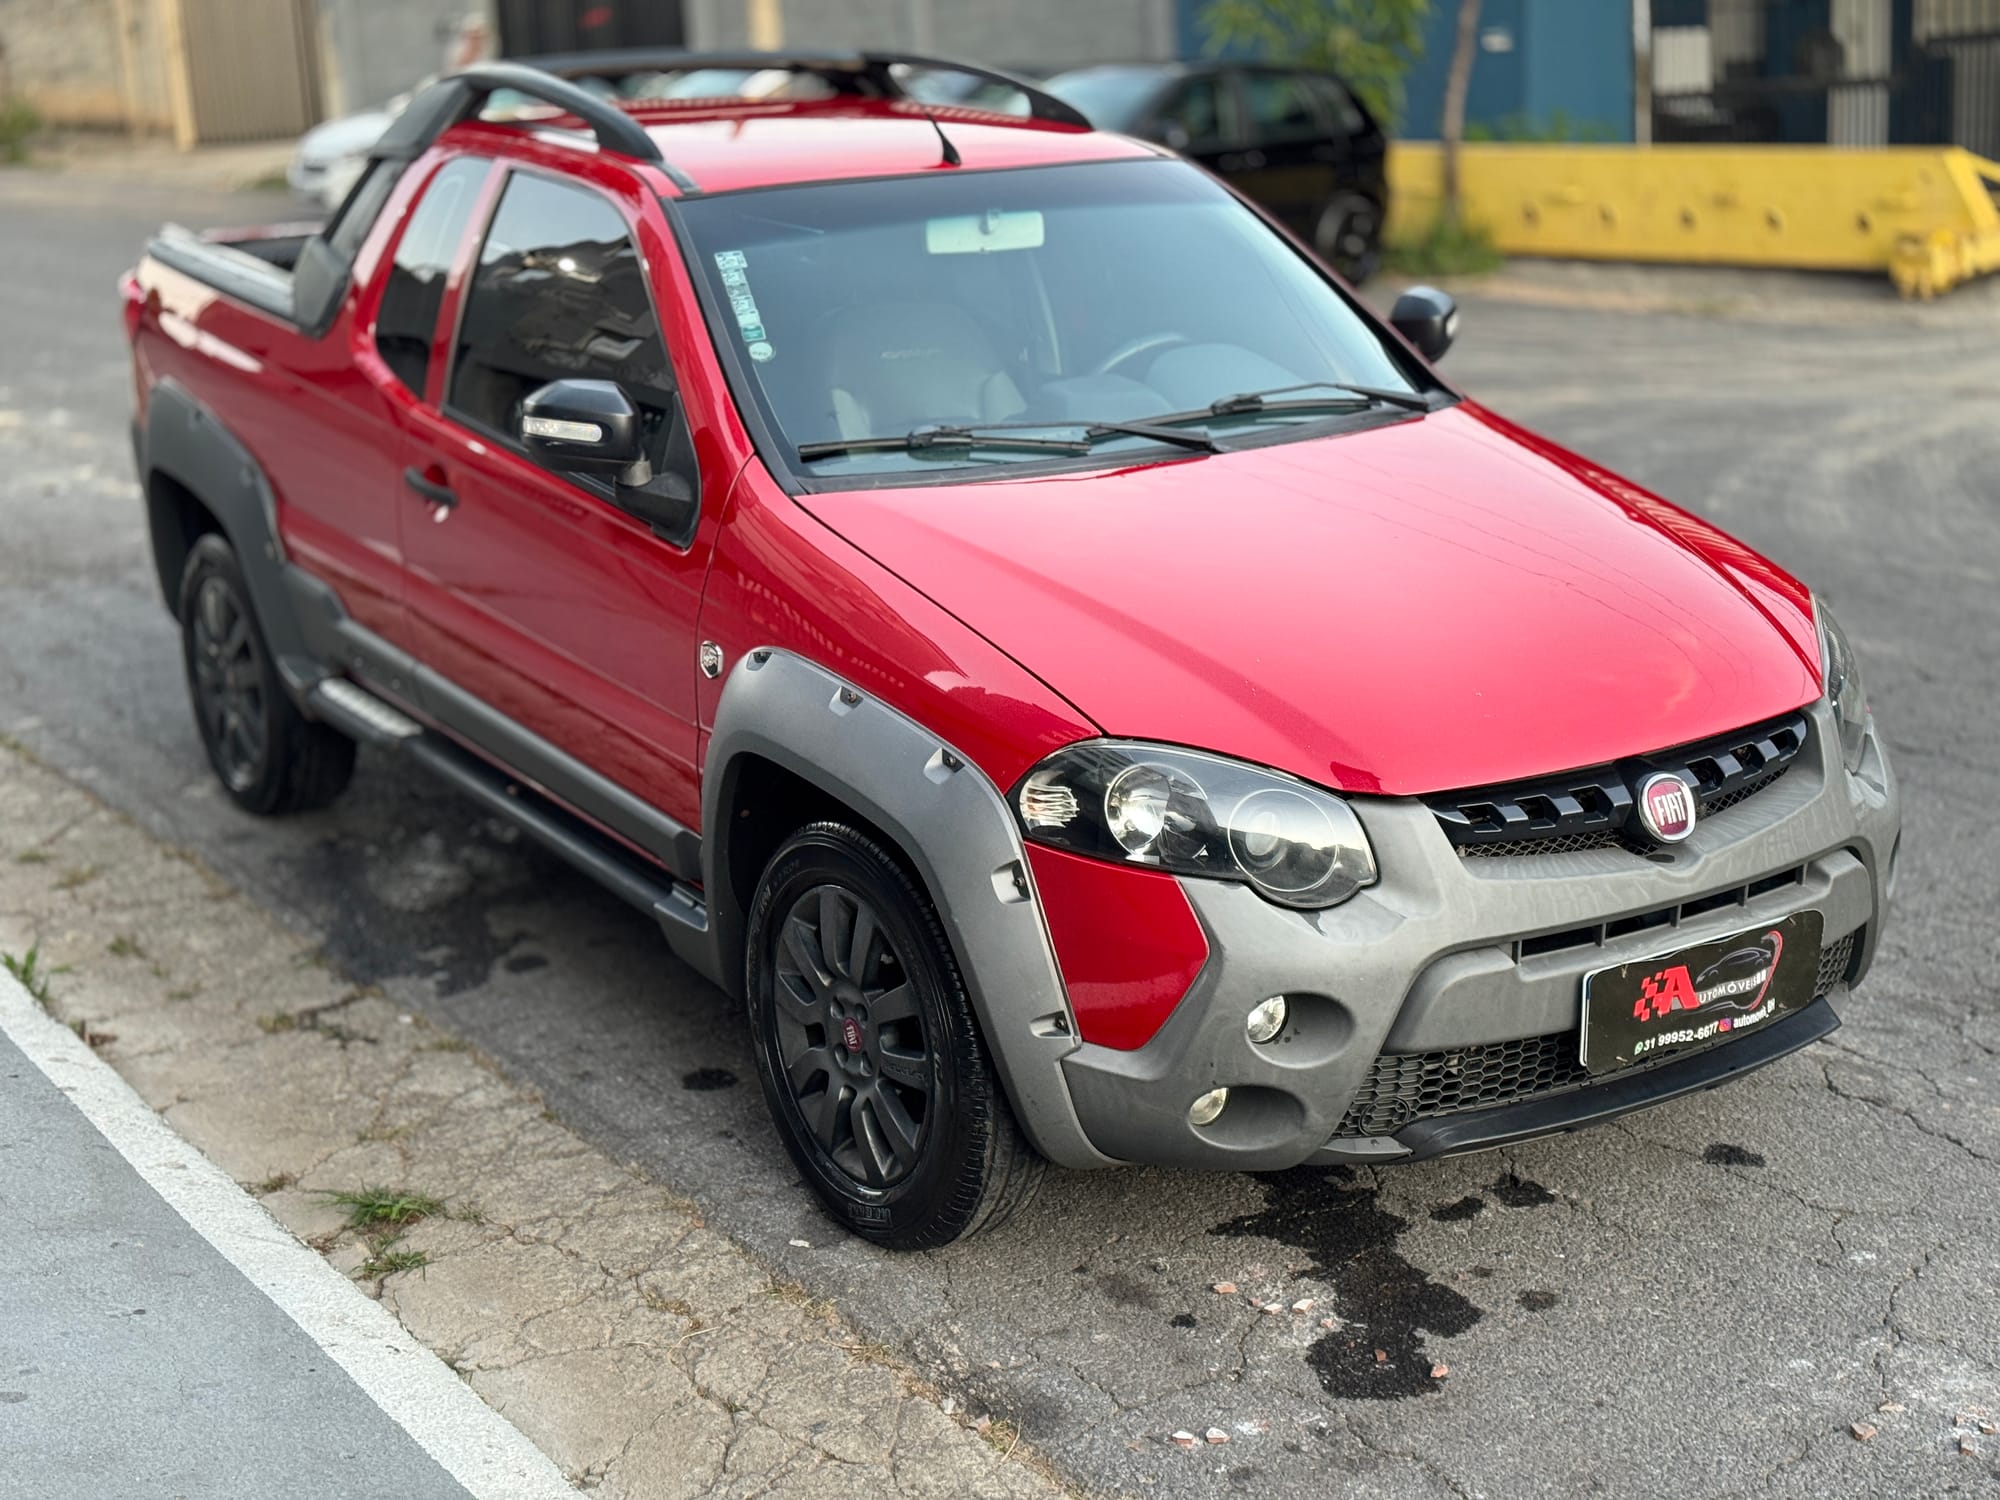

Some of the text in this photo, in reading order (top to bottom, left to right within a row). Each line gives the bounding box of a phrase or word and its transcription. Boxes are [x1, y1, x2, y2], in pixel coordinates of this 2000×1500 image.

[1653, 791, 1686, 827] FIAT
[846, 1024, 858, 1045] FIAT
[1643, 1021, 1719, 1051] 31 99952-6677
